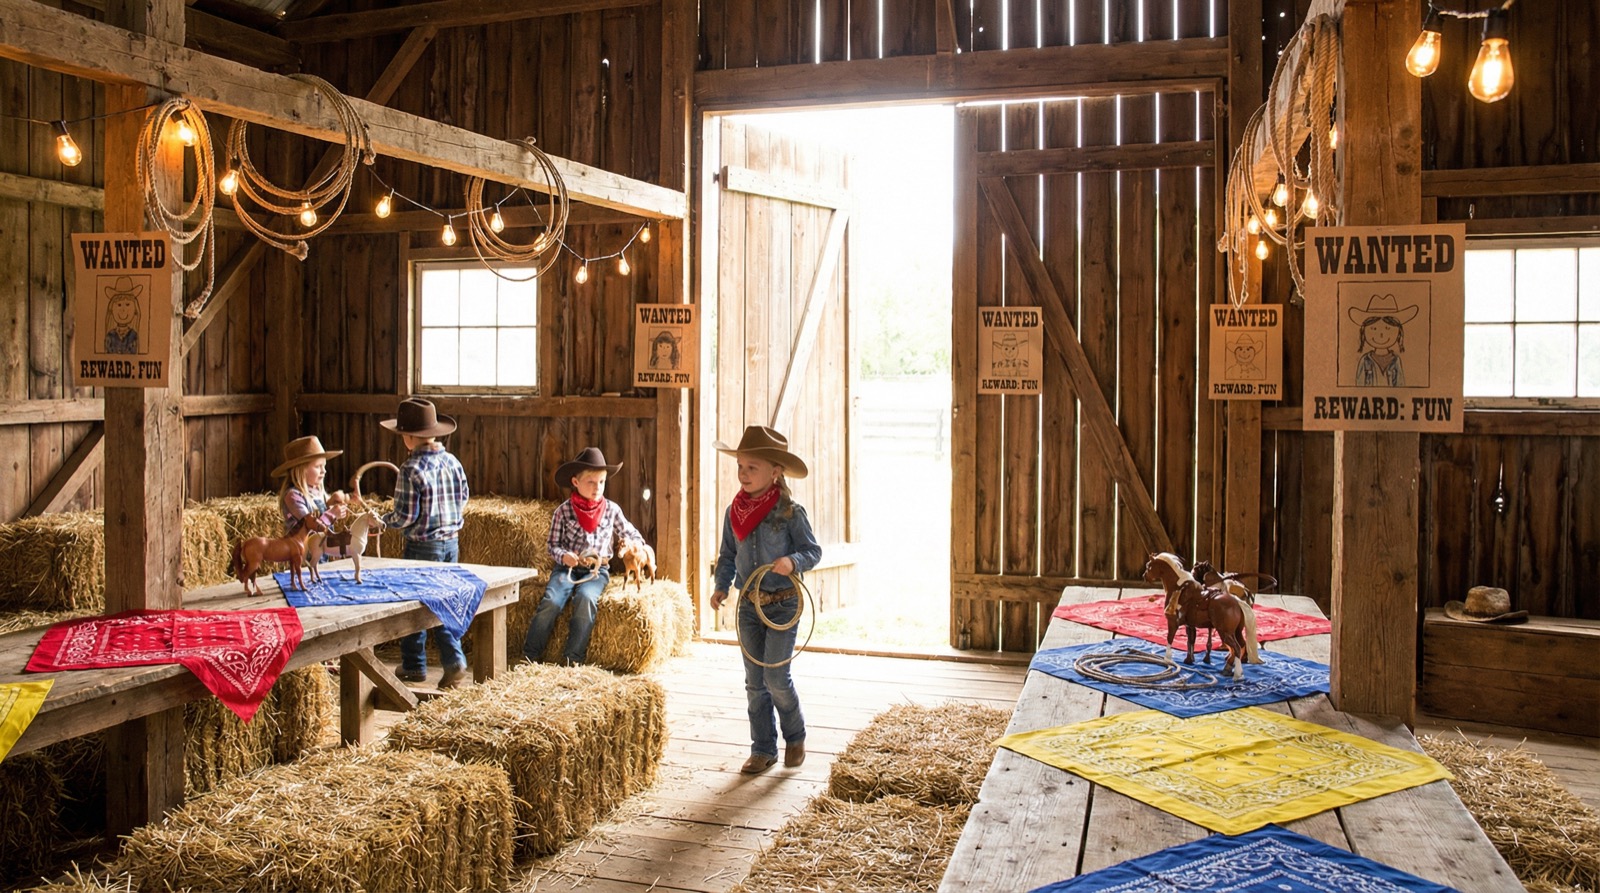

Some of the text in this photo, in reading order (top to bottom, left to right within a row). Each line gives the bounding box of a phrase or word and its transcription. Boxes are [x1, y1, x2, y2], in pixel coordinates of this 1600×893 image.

[80, 239, 166, 270] WANTED
[1314, 234, 1455, 274] WANTED
[640, 308, 692, 324] WANTED
[982, 311, 1039, 328] WANTED
[1214, 309, 1278, 327] WANTED
[80, 360, 162, 380] REWARD: FUN
[638, 373, 690, 383] REWARD: FUN
[982, 379, 1038, 390] REWARD: FUN
[1213, 383, 1277, 395] REWARD: FUN
[1314, 396, 1453, 421] REWARD: FUN
